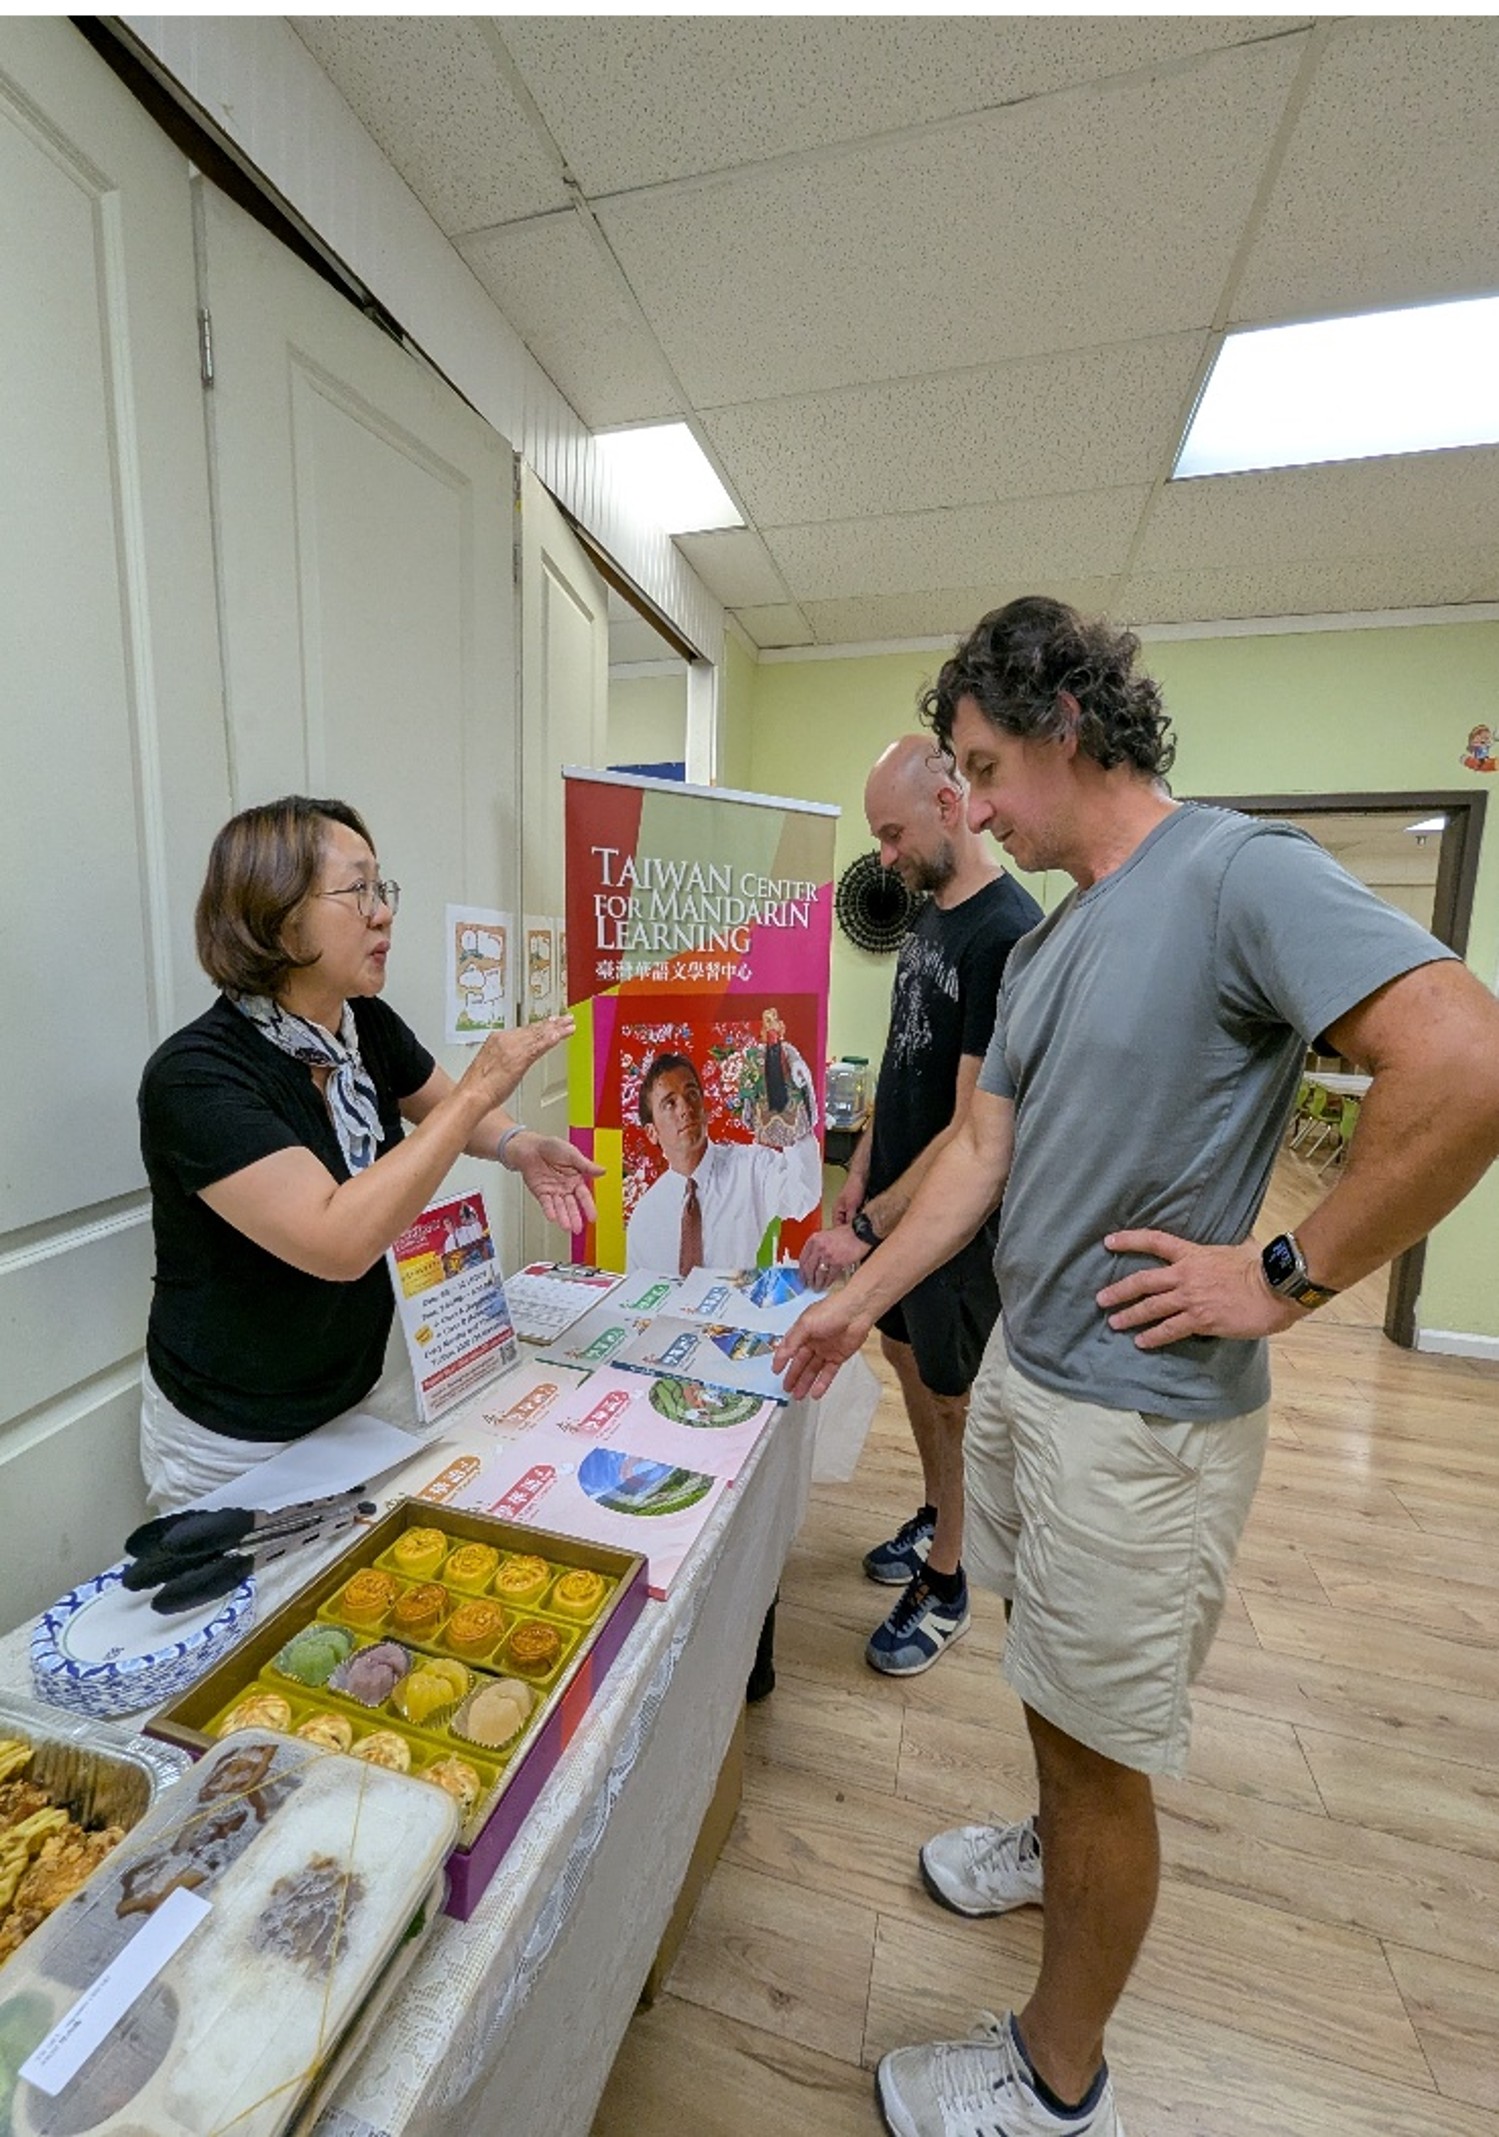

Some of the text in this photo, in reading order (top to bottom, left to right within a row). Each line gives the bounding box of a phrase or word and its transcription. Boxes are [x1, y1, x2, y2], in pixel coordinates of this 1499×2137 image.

[591, 846, 818, 902] TAIWAN CENTER
[593, 888, 810, 929] FOR MANDARIN
[596, 915, 752, 953] LEARNING
[595, 959, 753, 981] 臺灣華語文學習中心
